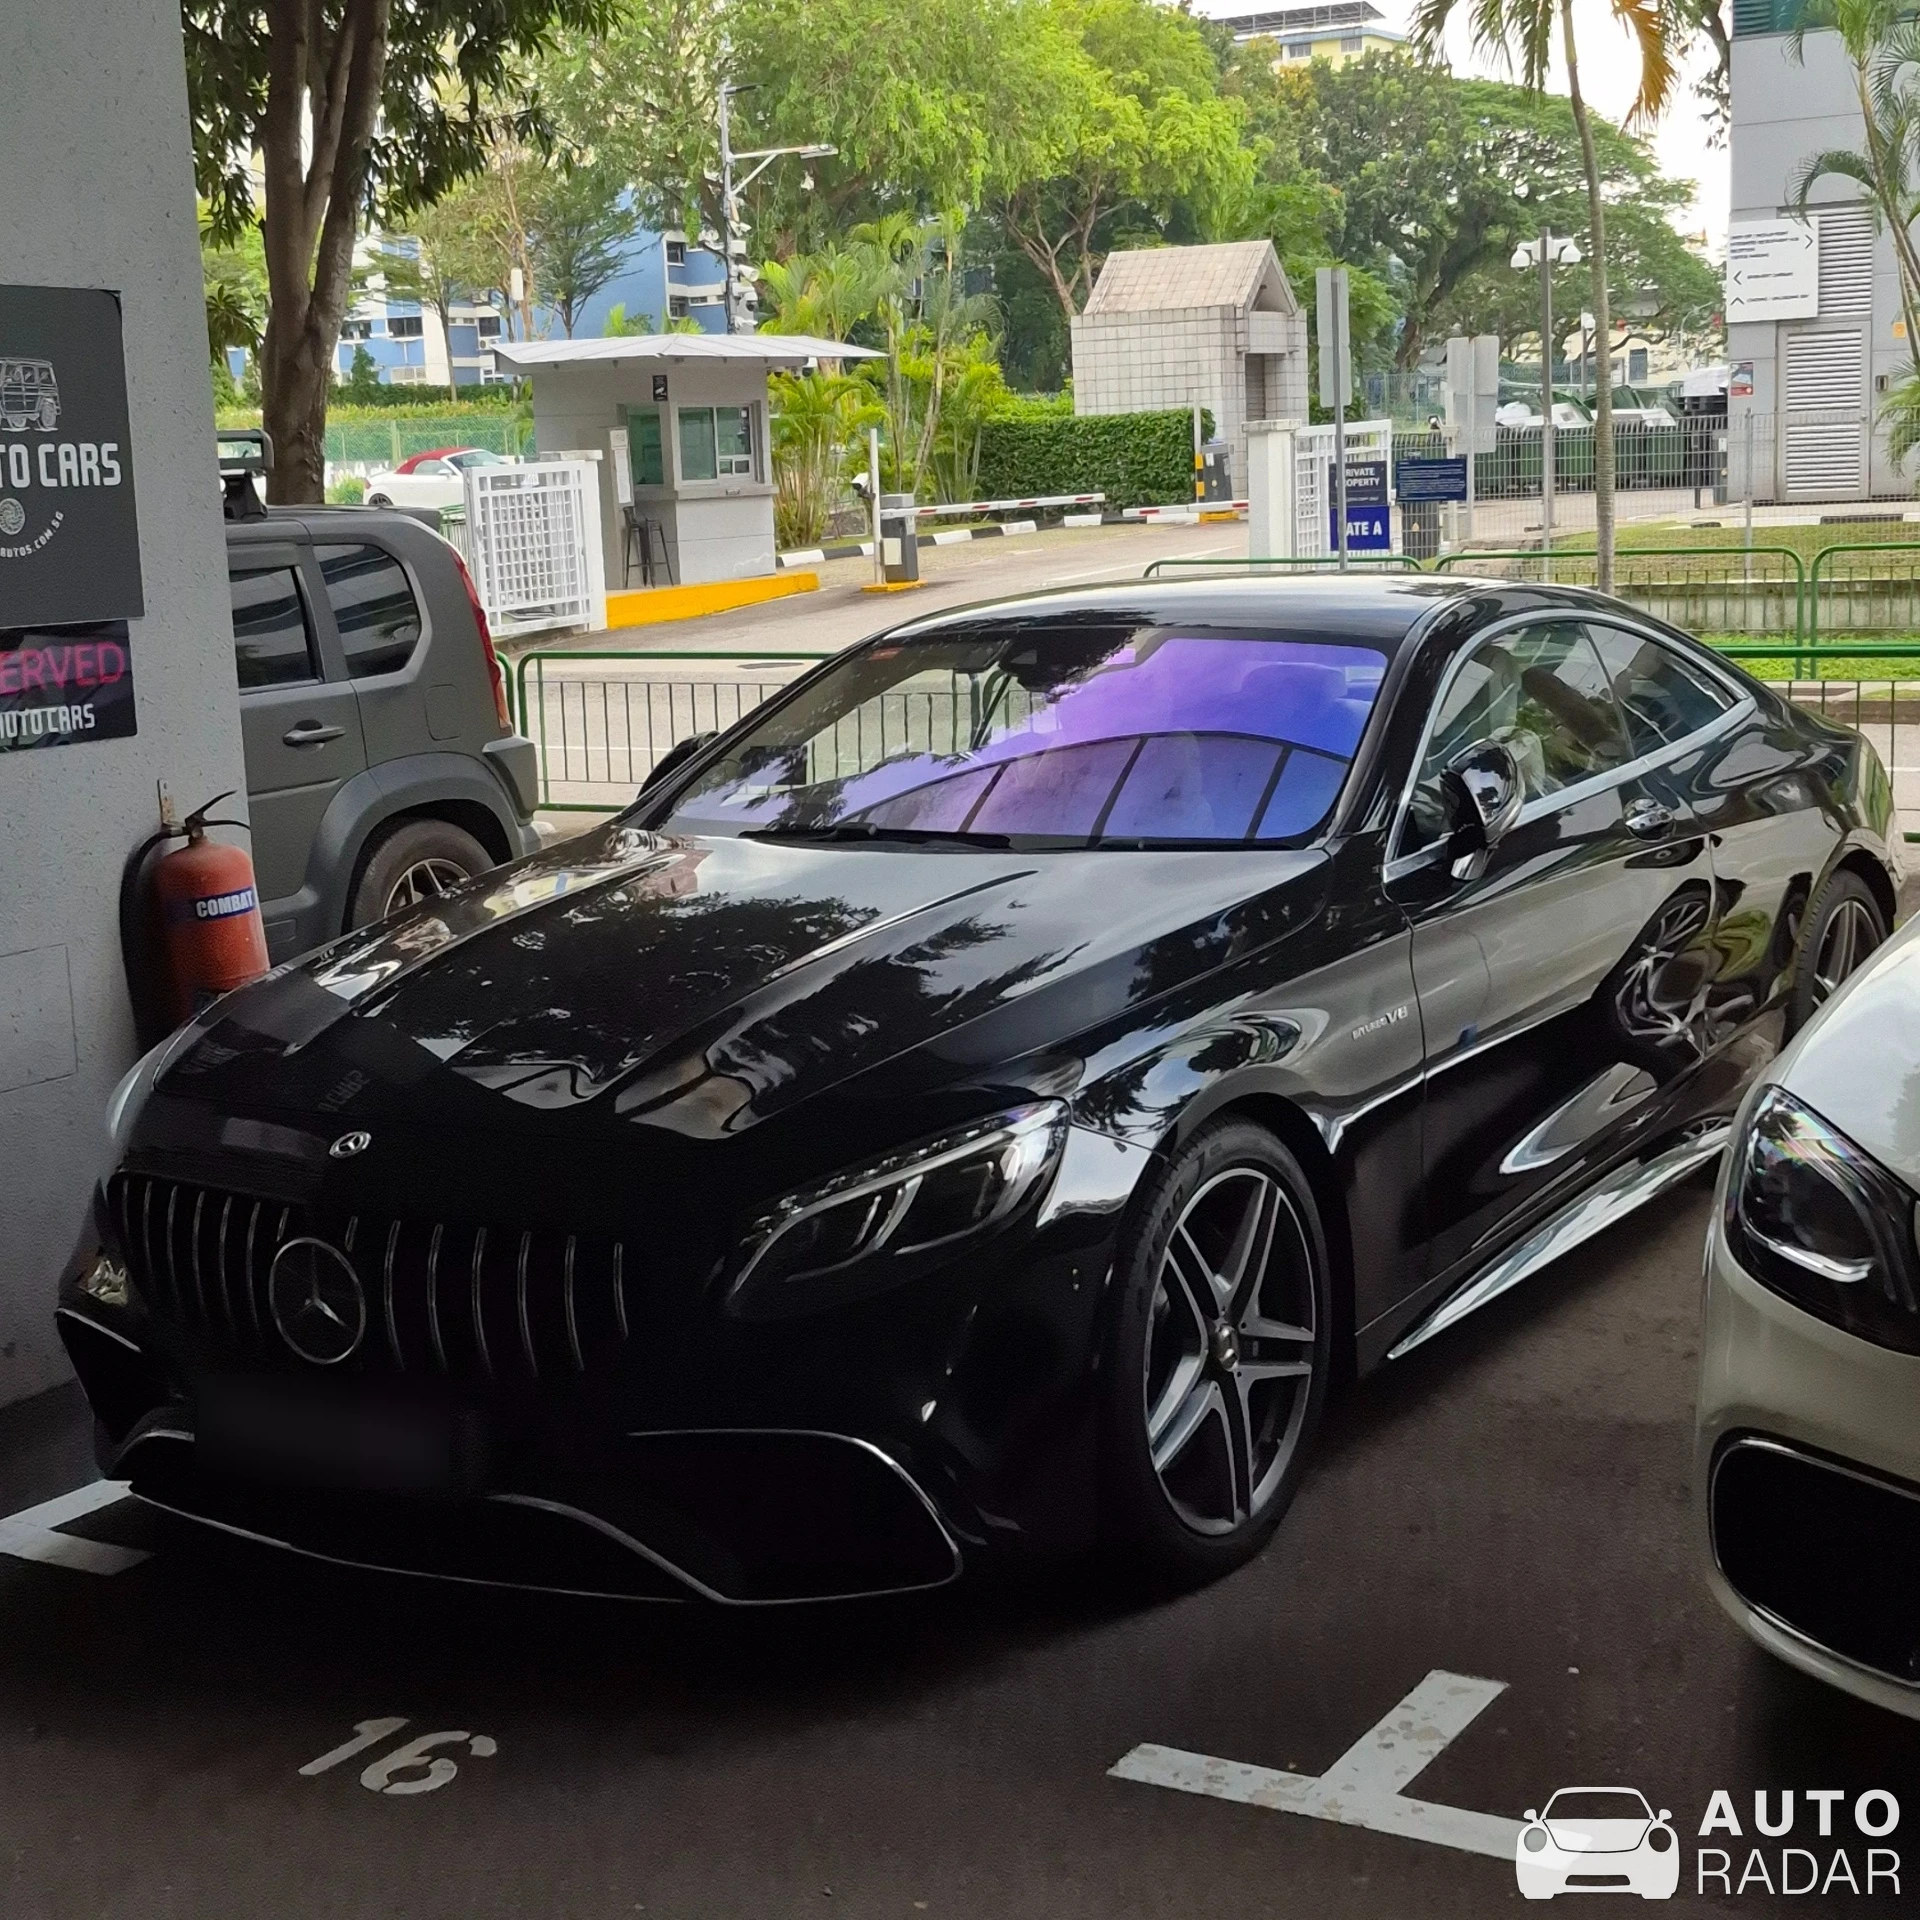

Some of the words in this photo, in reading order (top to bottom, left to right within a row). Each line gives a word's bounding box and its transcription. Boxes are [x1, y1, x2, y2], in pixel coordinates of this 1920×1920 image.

[37, 442, 122, 487] CARS
[1345, 467, 1375, 477] RIVATE
[1335, 477, 1380, 487] OPERTY
[1345, 521, 1370, 537] ATE
[1372, 520, 1383, 536] A
[196, 890, 255, 918] COMBAT
[297, 1716, 498, 1795] 16
